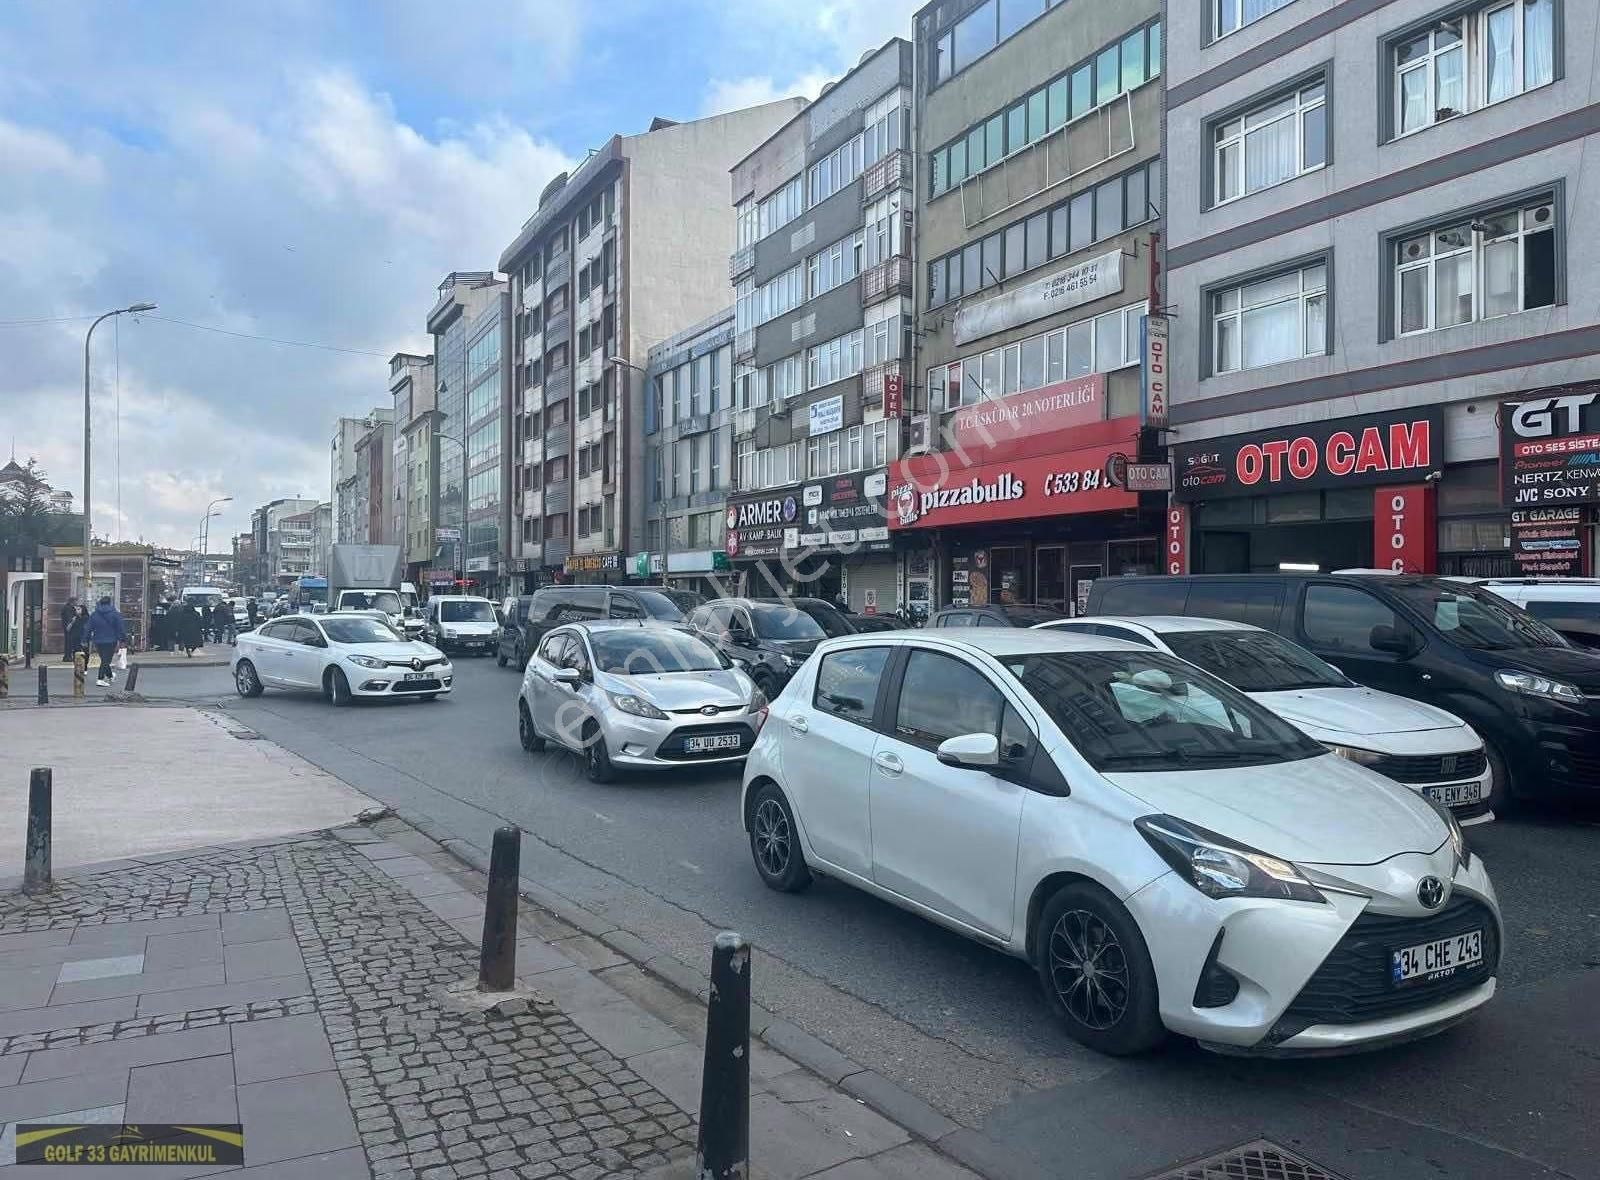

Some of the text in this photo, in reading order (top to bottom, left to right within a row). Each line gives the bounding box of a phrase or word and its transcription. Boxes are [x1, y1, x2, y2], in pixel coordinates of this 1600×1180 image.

[1051, 286, 1065, 298] 0216
[1067, 281, 1078, 290] 461
[1080, 277, 1088, 287] 55
[1089, 274, 1097, 284] 54
[1151, 342, 1163, 374] OTO
[888, 373, 898, 419] NOTER
[1152, 382, 1163, 414] CAM
[1511, 393, 1598, 437] GT
[1236, 420, 1429, 485] OTO CAM
[1522, 438, 1600, 454] OTO SES SİSTE
[1054, 472, 1079, 494] 533
[1082, 469, 1100, 491] 84
[1128, 466, 1169, 480] OTO CAM
[1514, 471, 1563, 485] HERTZ
[891, 483, 913, 499] pizza
[920, 472, 1024, 515] pizzabulls
[1515, 488, 1538, 502] JVC
[1544, 486, 1589, 499] SONY
[738, 500, 782, 527] ARMER
[1392, 495, 1405, 549] OTO
[1511, 507, 1581, 522] GT GARAGE
[1170, 510, 1181, 555] OTO
[691, 738, 701, 749] 34
[718, 735, 738, 747] 2533
[1431, 788, 1442, 802] 34
[1445, 787, 1461, 801] ENY
[1402, 950, 1419, 976] 34
[1425, 941, 1451, 970] CHE
[1457, 932, 1480, 962] 243
